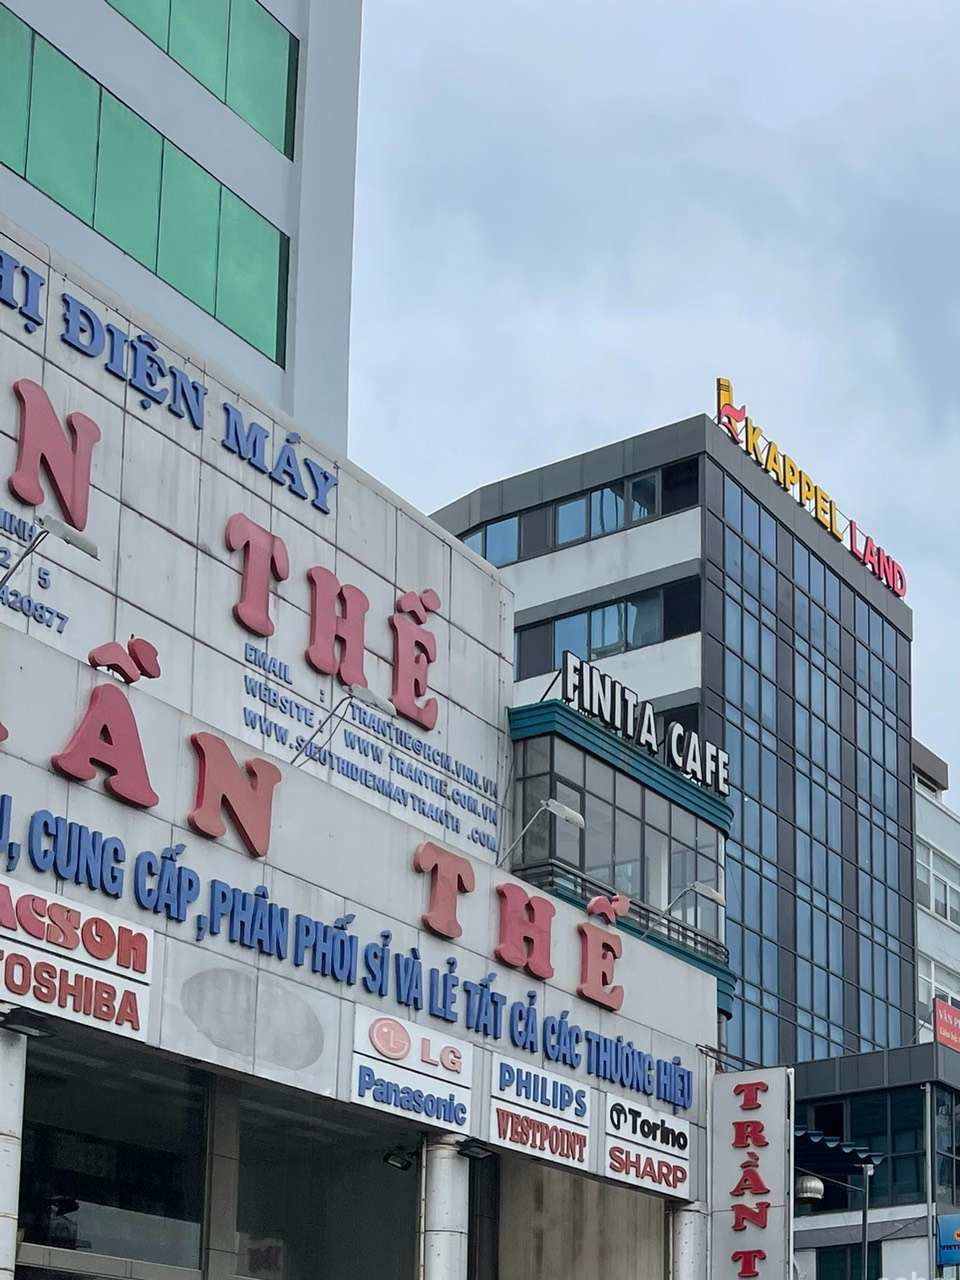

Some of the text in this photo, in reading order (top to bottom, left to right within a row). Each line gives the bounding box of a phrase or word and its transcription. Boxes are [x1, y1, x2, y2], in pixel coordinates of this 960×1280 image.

[61, 293, 208, 430] ĐIỆN
[223, 400, 338, 514] MÁY
[0, 508, 36, 542] INH
[745, 416, 908, 598] KAPPEL LAND
[244, 642, 293, 685] EMAIL
[243, 675, 314, 728] WEBSITE
[562, 651, 730, 796] FINITA CAFE
[0, 633, 282, 858] ẦN
[29, 809, 126, 899] CUNG
[293, 914, 359, 986] PHỐI
[394, 947, 424, 1010] VÀ
[428, 956, 460, 1023] LẺ
[463, 972, 507, 1040] TẤT
[510, 990, 538, 1053] CẢ
[542, 1010, 583, 1070] CÁC
[0, 950, 141, 1032] OSHIBA
[421, 1038, 462, 1074] LG
[358, 1065, 467, 1126] Panasonic
[499, 1062, 587, 1118] PHILIPS
[496, 1107, 588, 1163] WESTPOINT
[628, 1107, 688, 1151] Torino
[729, 1081, 771, 1232] TRẦN
[609, 1146, 688, 1189] SHARP
